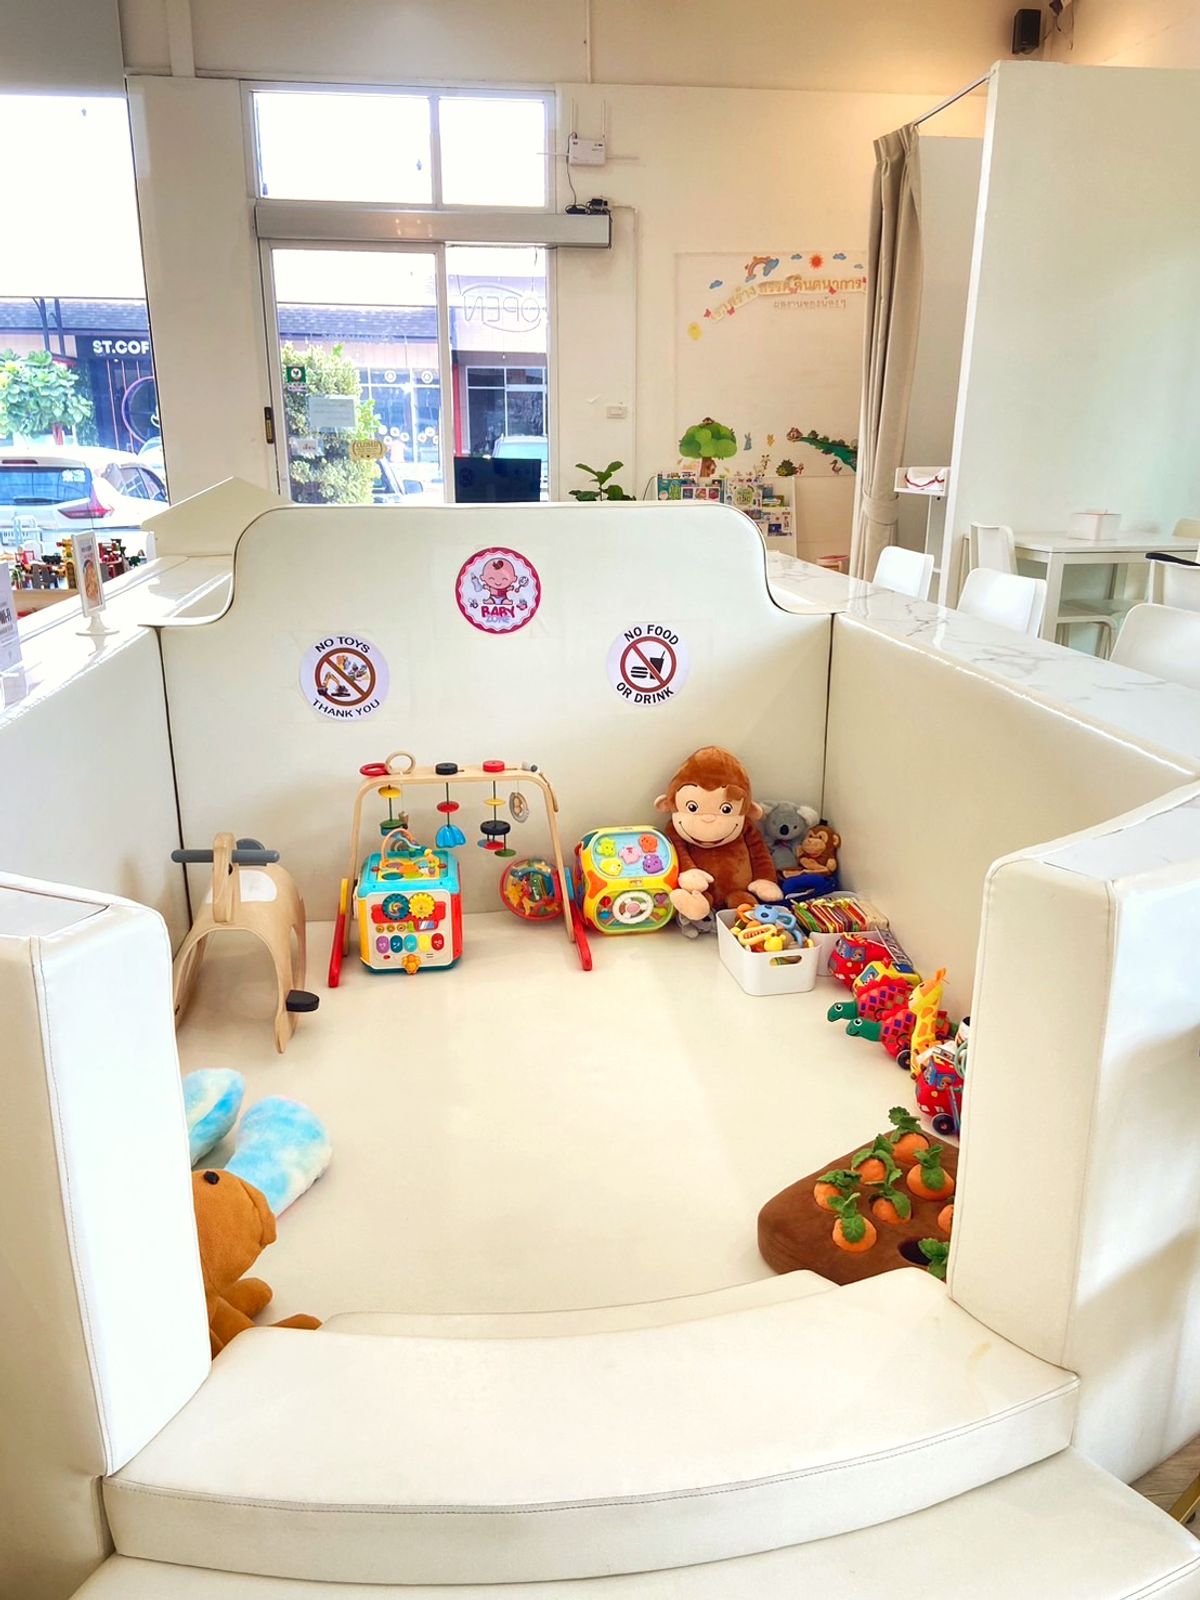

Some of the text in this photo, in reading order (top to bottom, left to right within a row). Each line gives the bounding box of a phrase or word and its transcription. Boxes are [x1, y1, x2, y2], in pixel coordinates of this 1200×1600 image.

[481, 606, 515, 618] BABY
[624, 624, 679, 645] NO FOOD
[315, 636, 371, 654] NO TOYS
[616, 682, 674, 704] OR DRINK
[312, 698, 380, 718] THANK YOU
